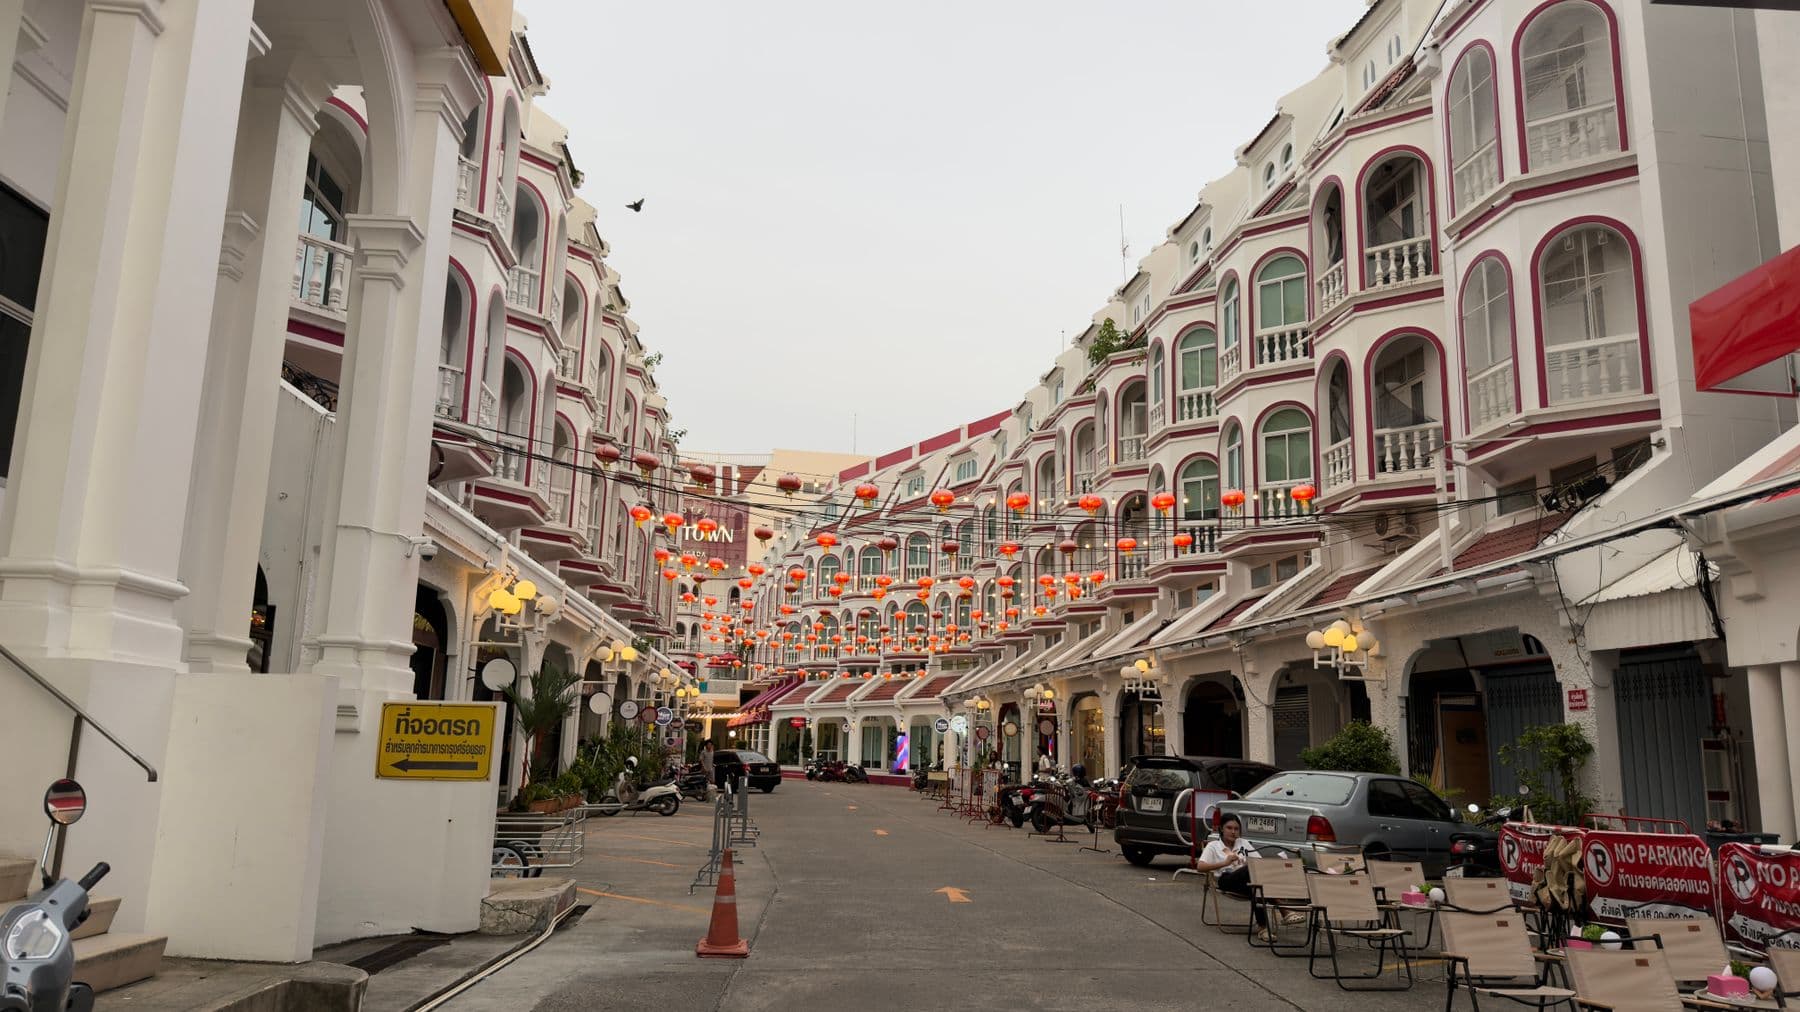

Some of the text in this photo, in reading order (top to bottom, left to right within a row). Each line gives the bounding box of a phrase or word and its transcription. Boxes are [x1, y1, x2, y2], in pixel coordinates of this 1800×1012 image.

[682, 525, 734, 543] TOWN
[395, 707, 480, 736] ที่จอดรถ
[1520, 838, 1534, 854] NO
[1614, 843, 1709, 869] NO PARKING
[1618, 869, 1710, 895] ห้ามจอดตลอดแนว
[1757, 862, 1786, 887] NO
